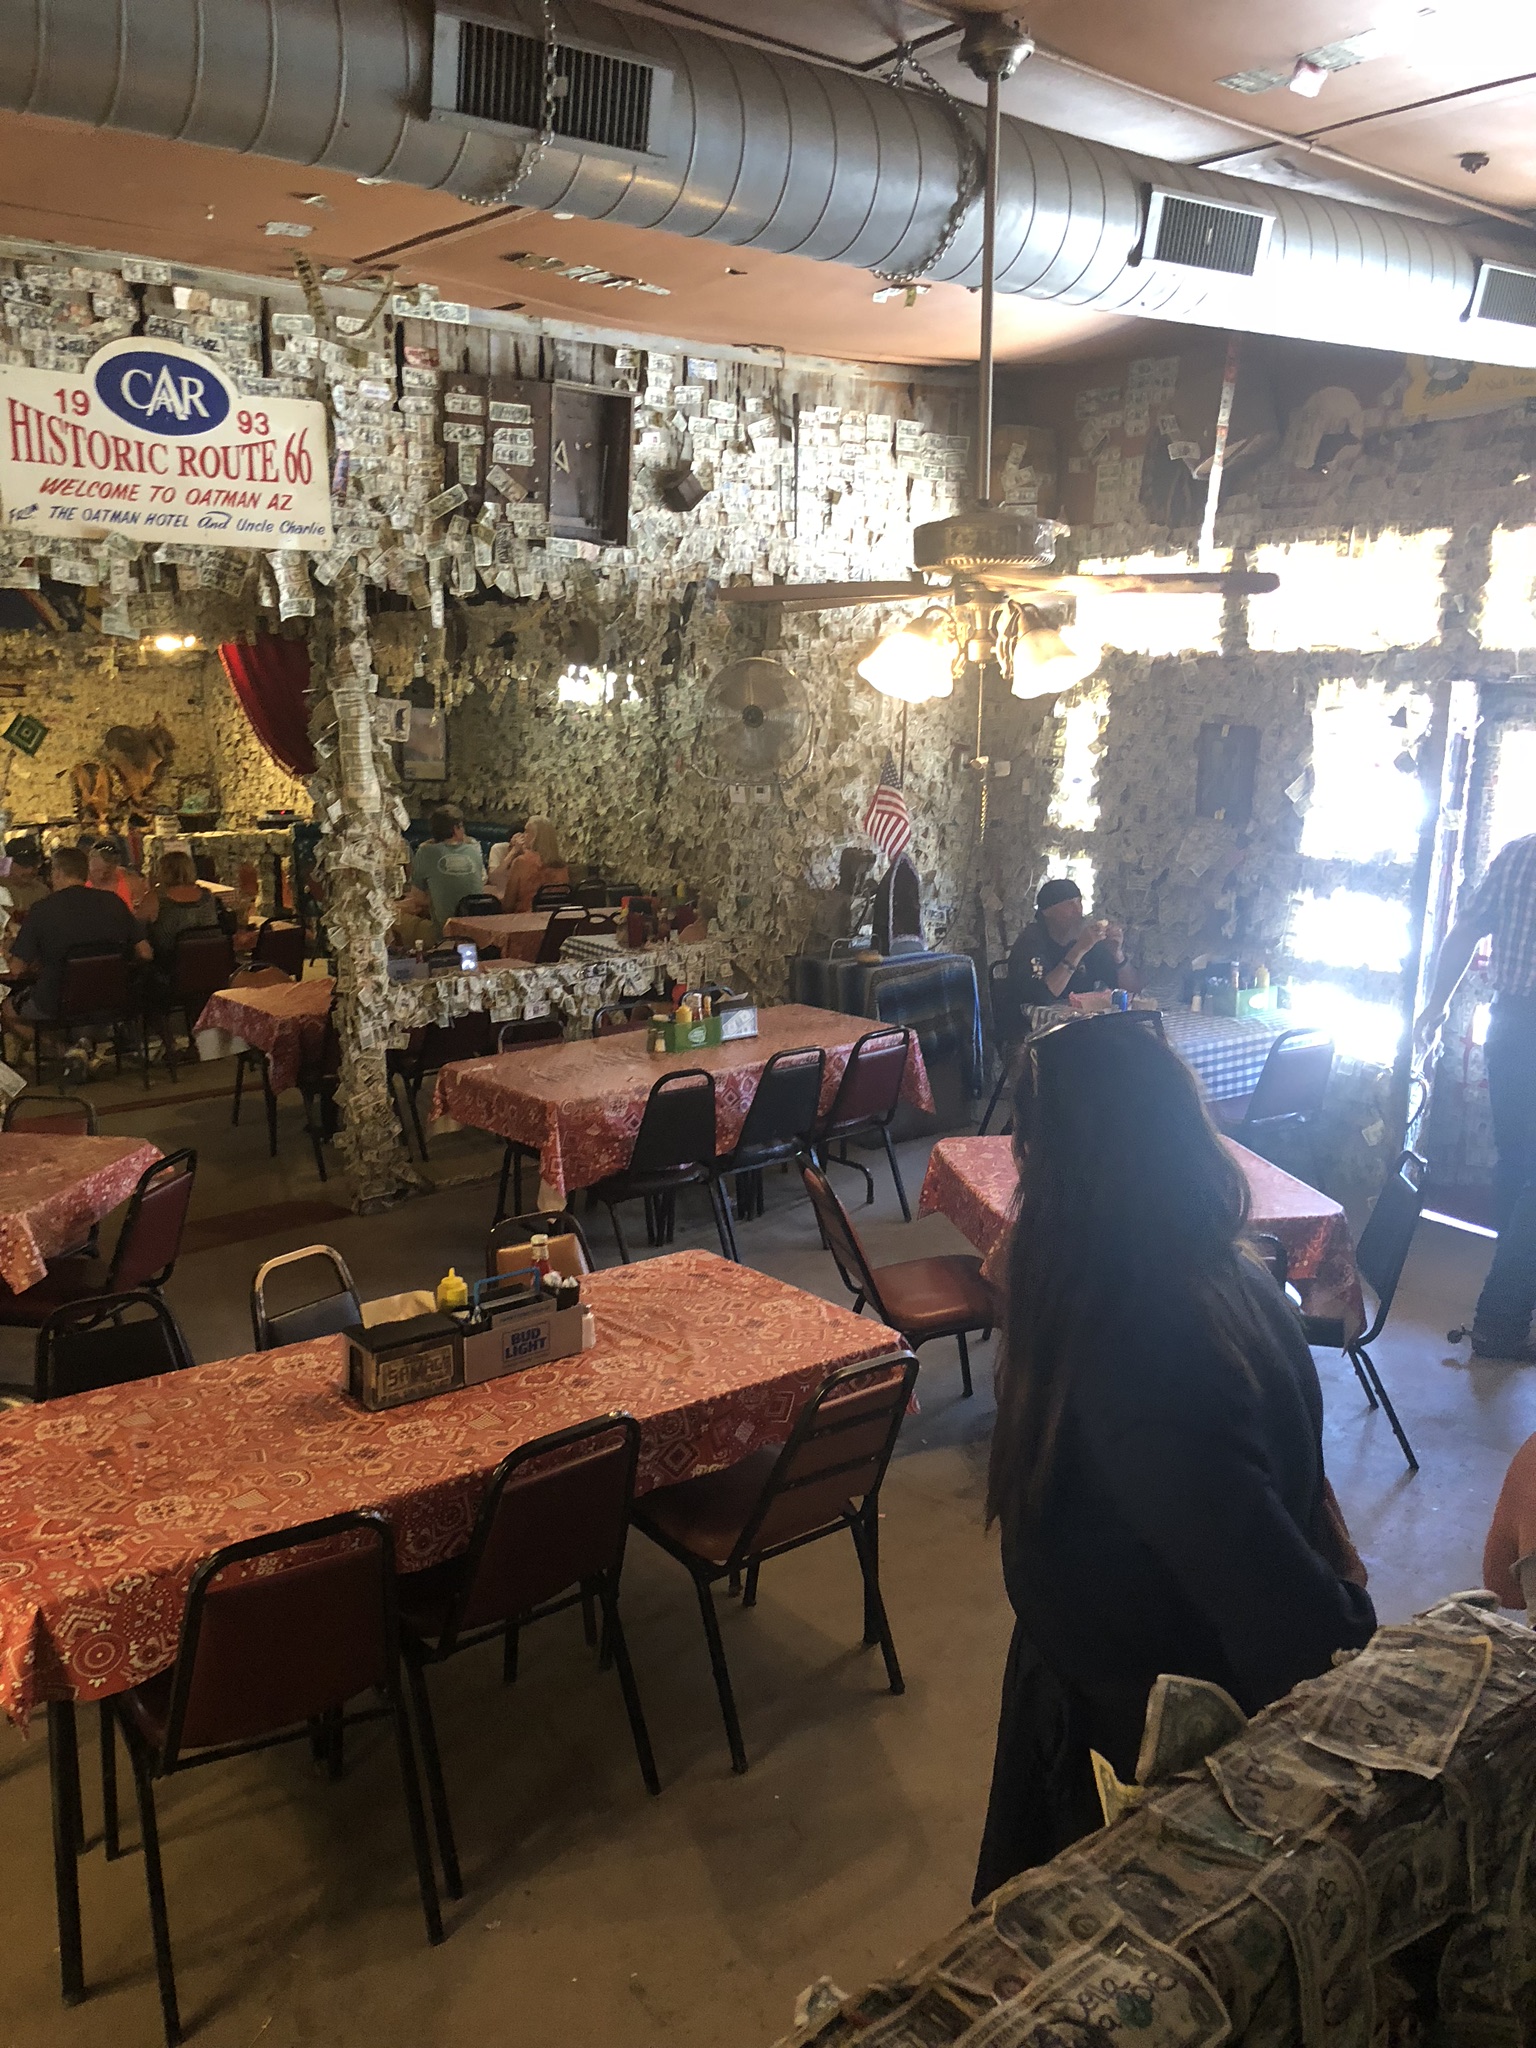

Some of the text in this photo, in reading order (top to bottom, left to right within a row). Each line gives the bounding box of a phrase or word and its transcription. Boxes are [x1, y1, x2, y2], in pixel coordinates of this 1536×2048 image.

[54, 388, 269, 436] 19 93
[8, 397, 312, 486] HISTORIC ROUTE 66
[39, 477, 293, 511] WELCOME TO OATMAN AZ
[50, 505, 75, 521] THE
[82, 508, 141, 526] OATMAN
[143, 514, 189, 528] HOTEL
[236, 518, 274, 534] Uncle
[278, 520, 326, 537] Charlie
[505, 1337, 547, 1359] LIGHT
[510, 1327, 541, 1345] BUD
